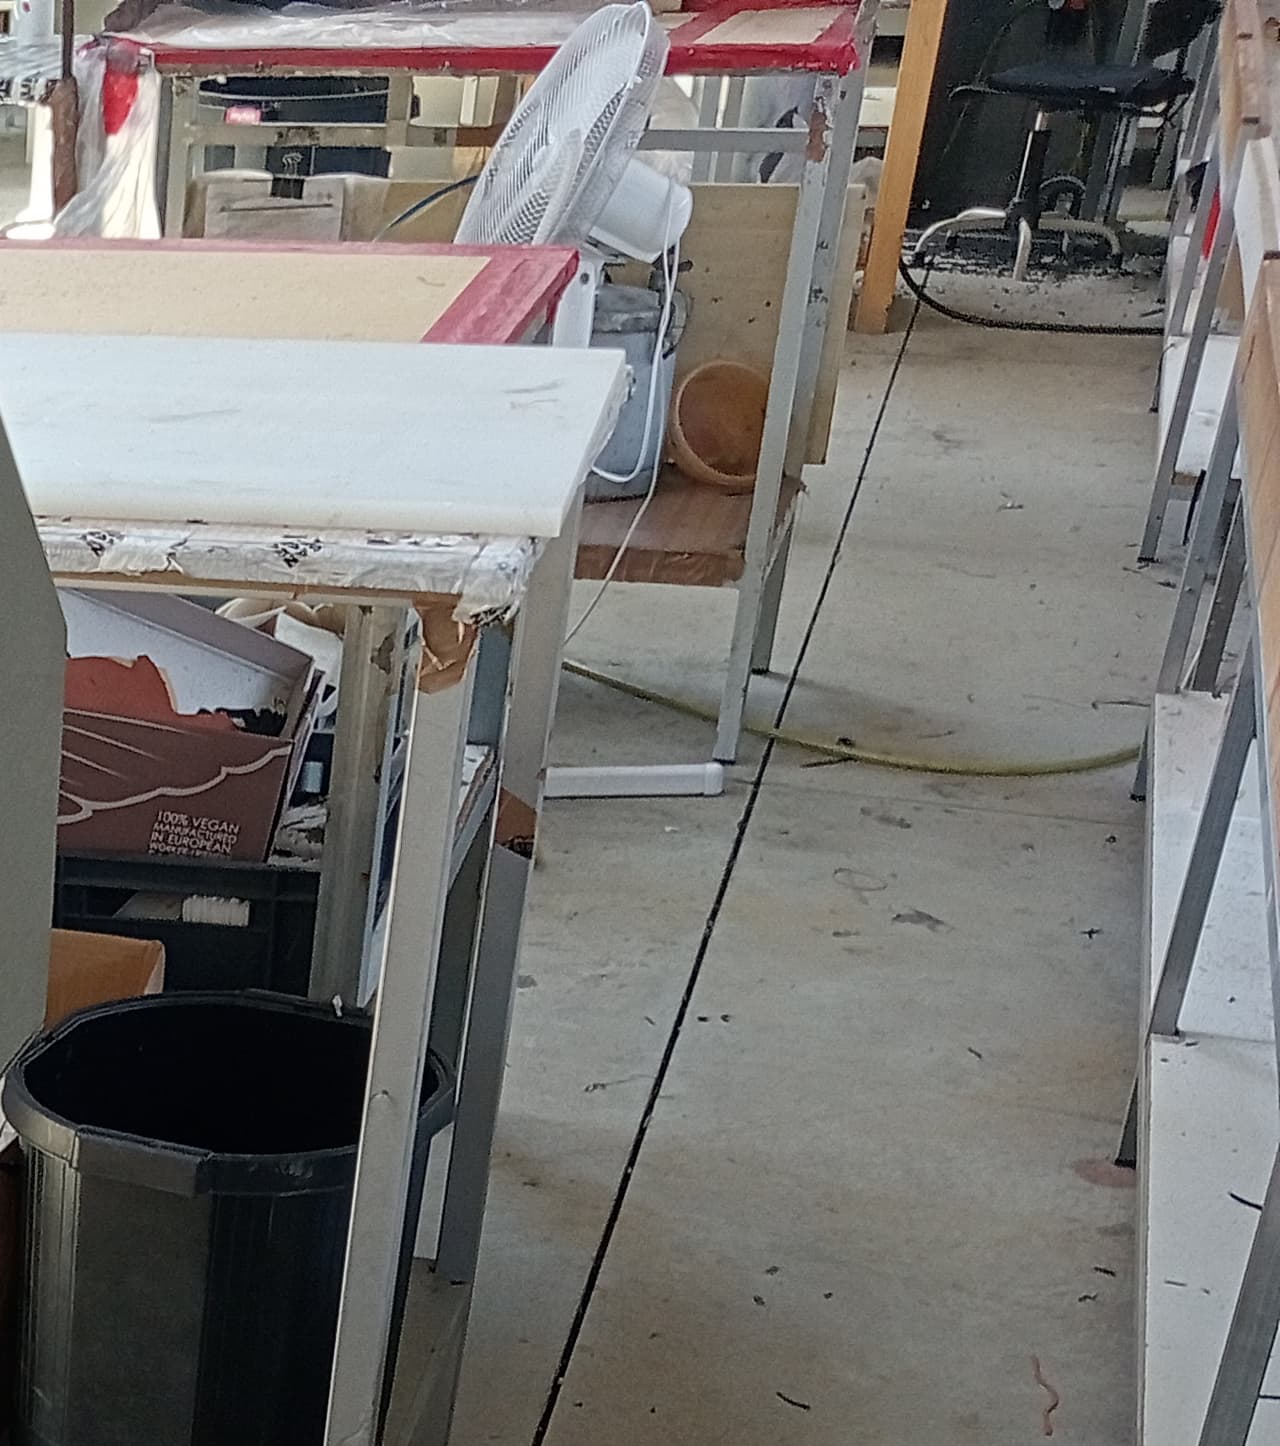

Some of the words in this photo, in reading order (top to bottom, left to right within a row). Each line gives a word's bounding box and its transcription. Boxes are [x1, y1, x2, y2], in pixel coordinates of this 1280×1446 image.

[153, 822, 238, 845] MANUFACTURED
[157, 810, 189, 826] 100%
[192, 817, 240, 835] VEGAN
[150, 831, 164, 843] IN
[167, 834, 232, 854] EUROPEAN
